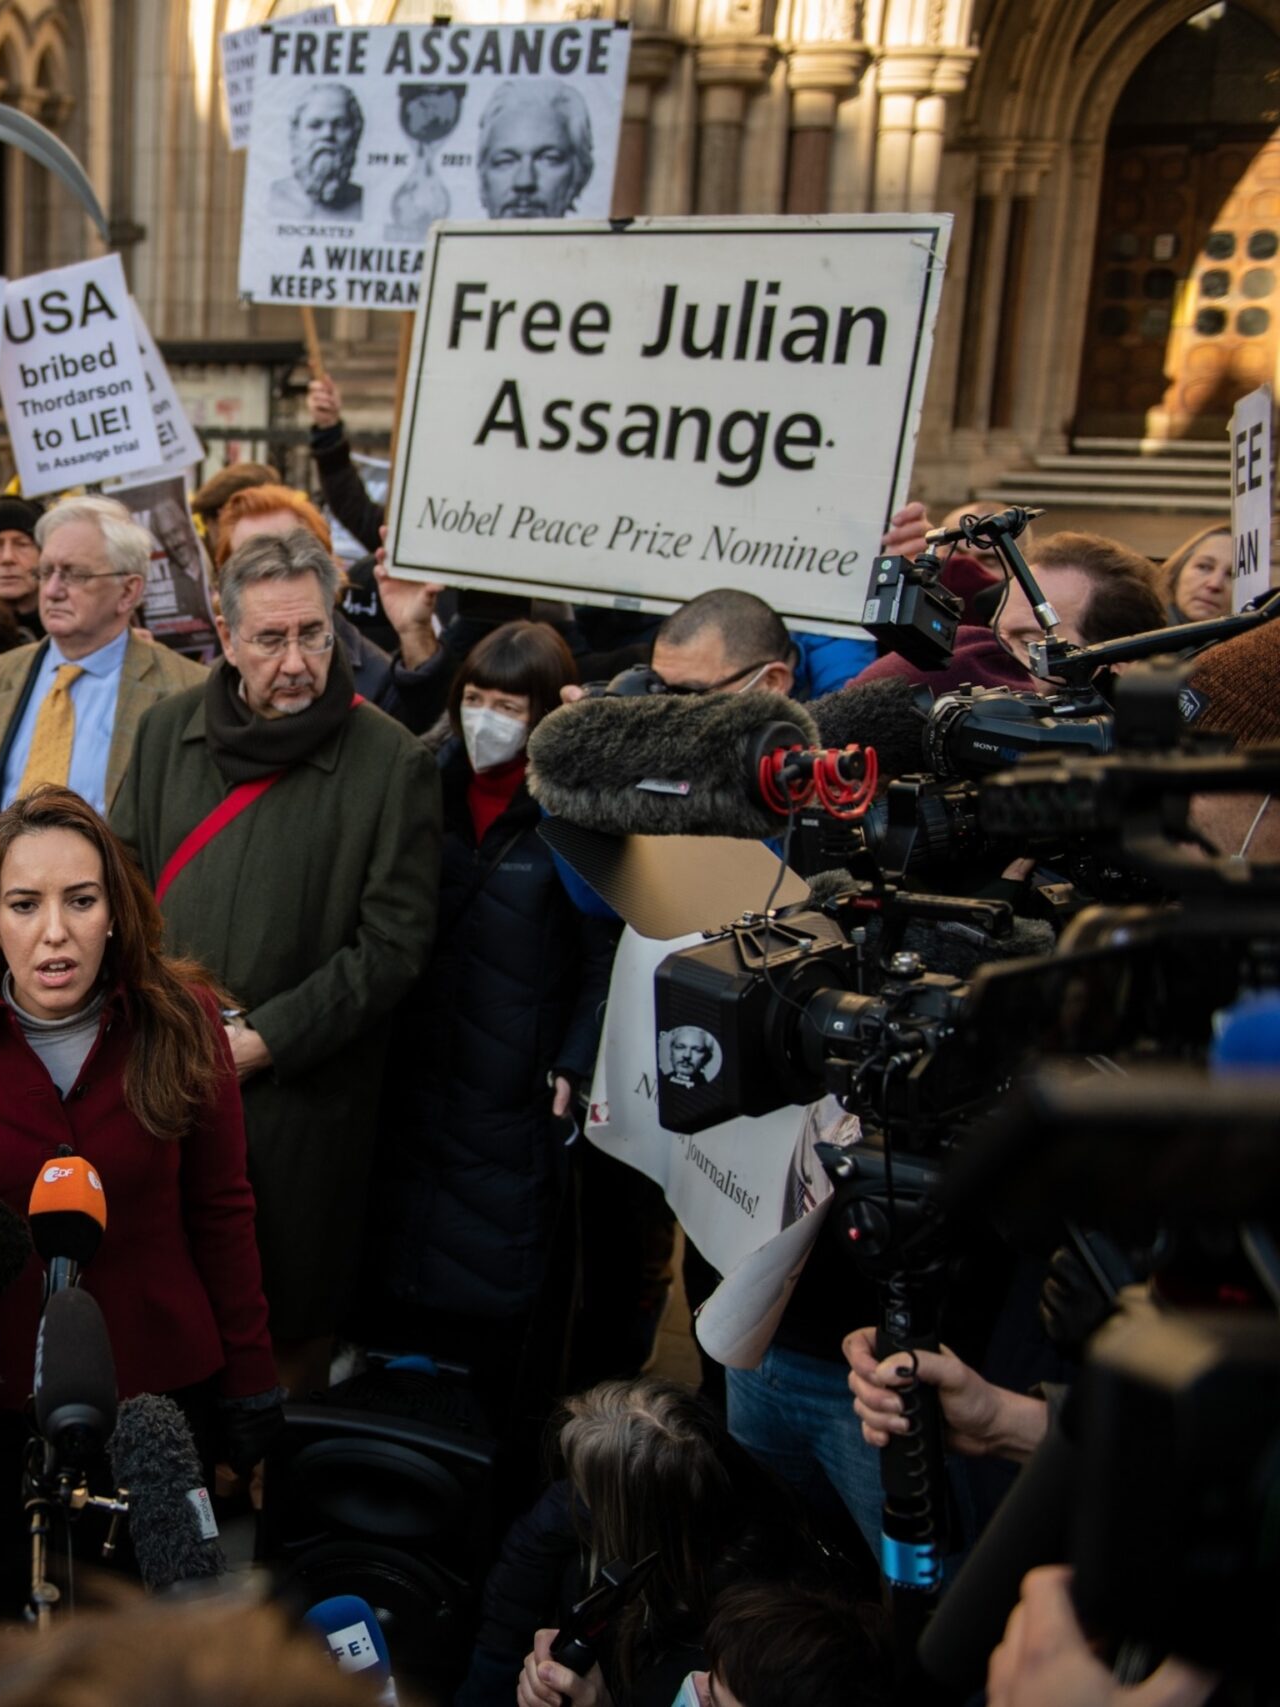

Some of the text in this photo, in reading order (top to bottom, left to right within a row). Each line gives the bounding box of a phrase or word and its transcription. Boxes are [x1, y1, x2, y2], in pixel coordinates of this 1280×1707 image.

[269, 27, 612, 76] FREE ASSANGE
[277, 224, 355, 239] SOCRATES
[299, 245, 425, 273] A WIKILEA
[5, 281, 118, 344] USA
[271, 274, 419, 304] KEEPS TYRAN
[448, 279, 887, 366] Free Julian
[19, 341, 117, 390] bribed
[18, 378, 133, 418] Thordarson
[33, 427, 63, 451] to
[70, 405, 131, 443] LIE!
[474, 379, 823, 488] Assange
[53, 447, 110, 470] Assange
[113, 439, 140, 455] trial
[1235, 422, 1263, 497] EE
[417, 496, 859, 577] Nobel Peace Prize Nominee
[973, 741, 999, 752] SONY
